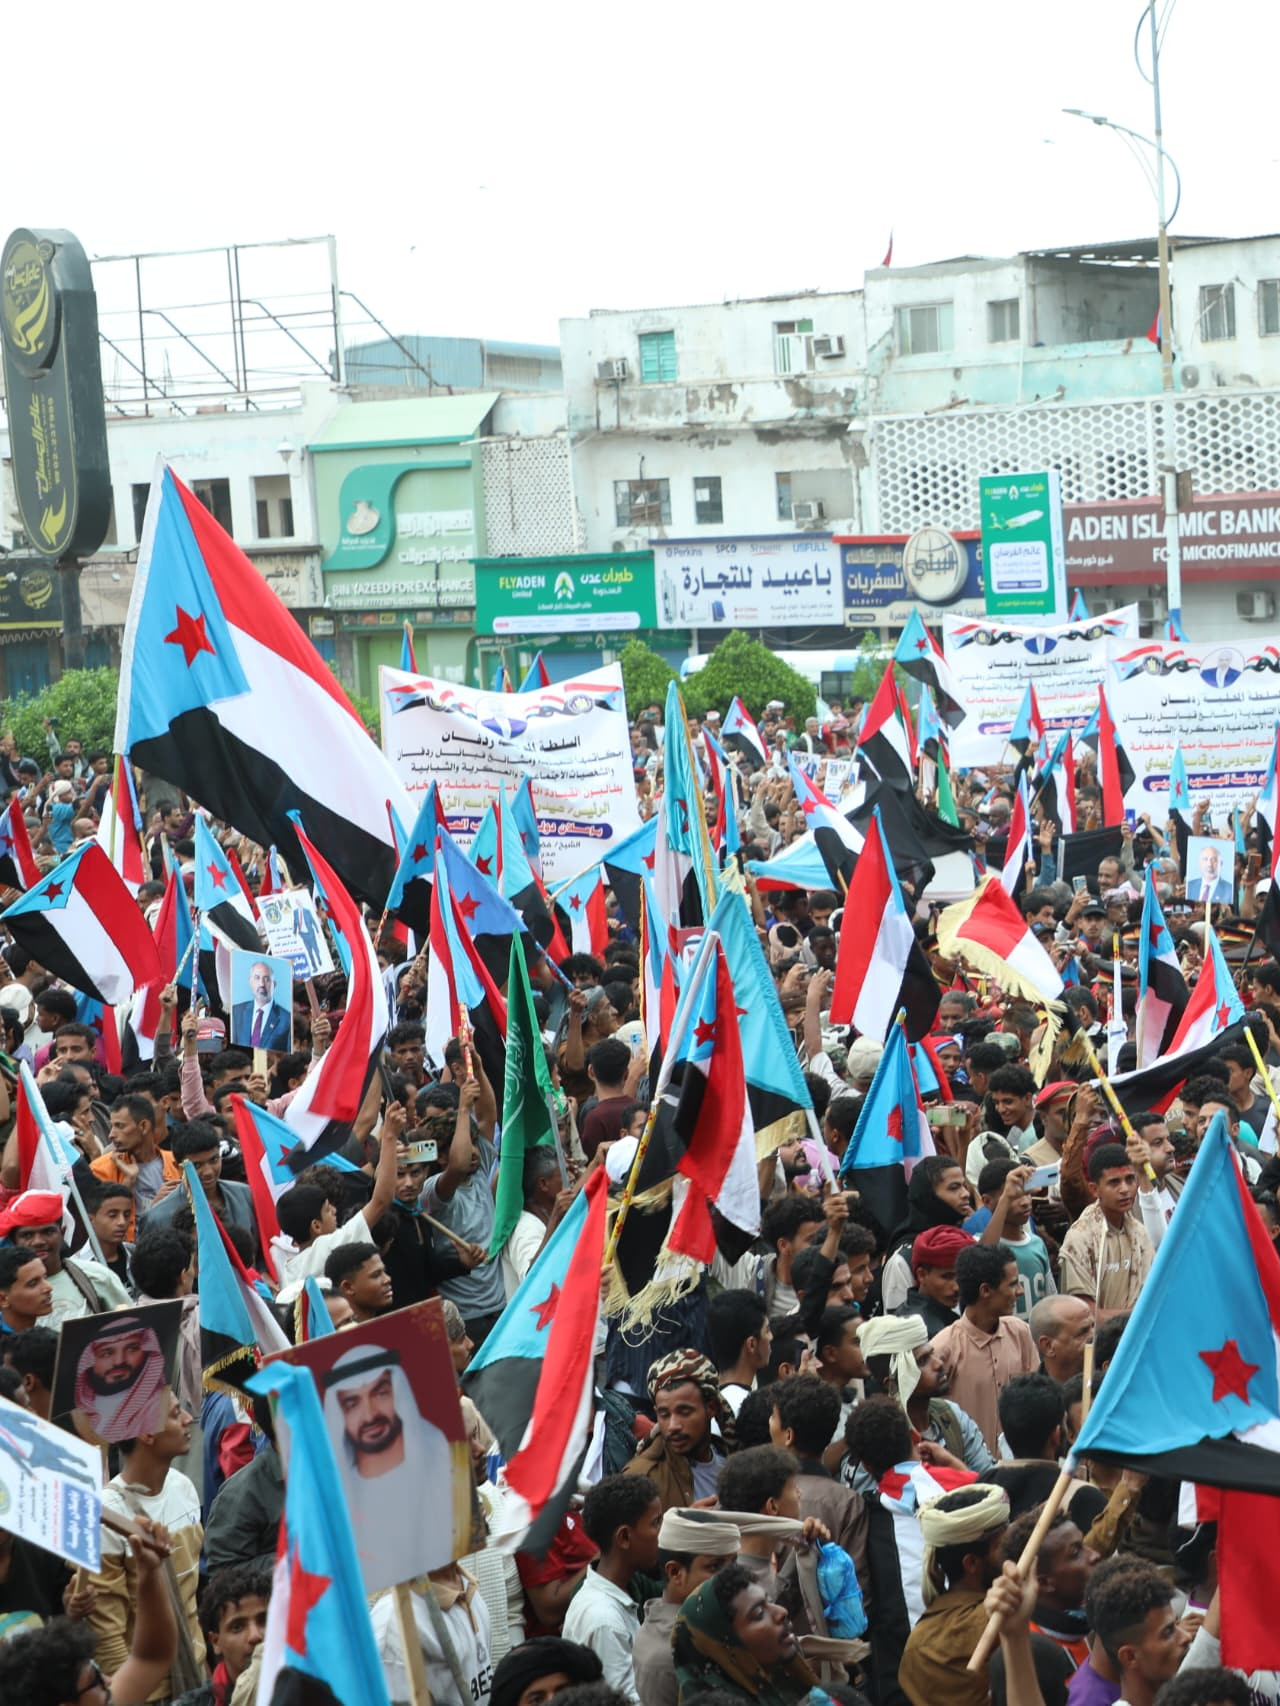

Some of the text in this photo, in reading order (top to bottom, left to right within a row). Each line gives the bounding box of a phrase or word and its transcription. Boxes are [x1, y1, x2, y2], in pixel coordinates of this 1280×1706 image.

[1068, 515, 1128, 542] ADEN
[332, 579, 473, 595] BIN YAZEED FOR EXCHANGE
[499, 576, 546, 589] FLYADEN
[580, 567, 634, 585] طيران عدن
[681, 562, 832, 597] باعبيد للتجارة
[847, 571, 905, 594] للسفريات
[442, 730, 582, 752] السلطة ردفان
